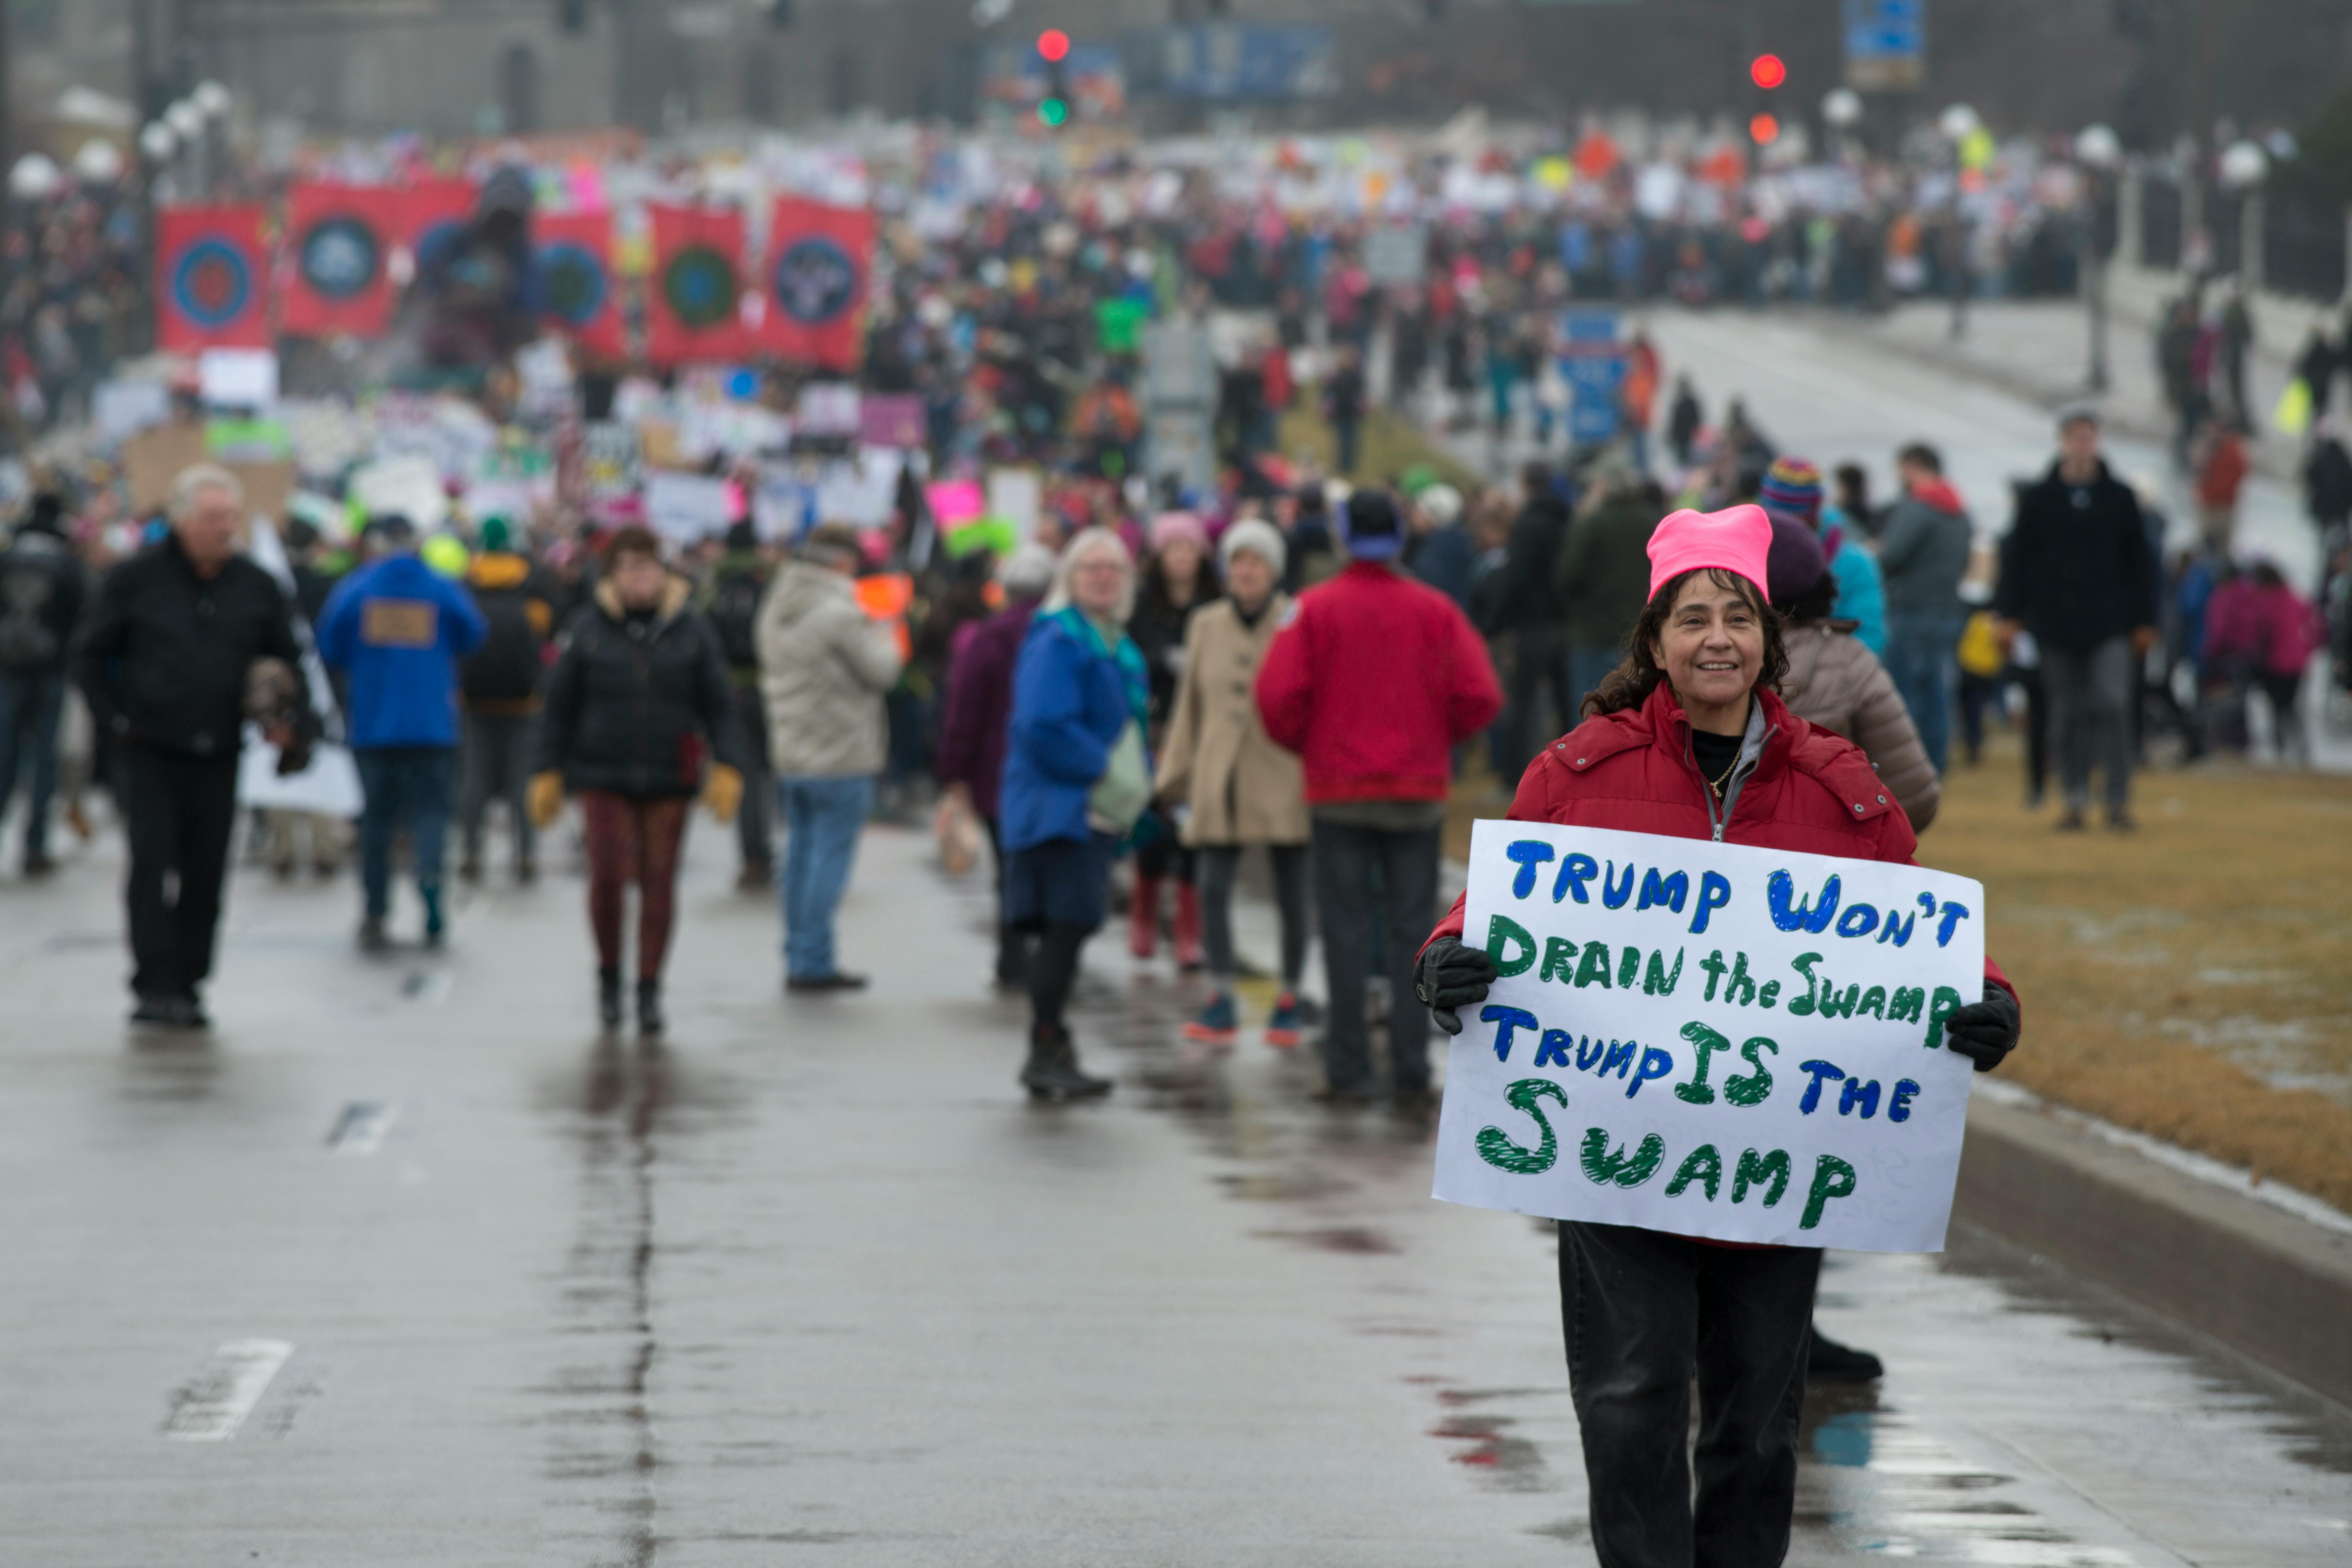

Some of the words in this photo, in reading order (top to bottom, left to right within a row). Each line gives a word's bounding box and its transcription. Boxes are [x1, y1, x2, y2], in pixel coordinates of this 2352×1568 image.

[1506, 840, 1731, 934] TRUMP
[1767, 868, 1970, 948] WON'T
[1485, 914, 1684, 996] DRAIN
[1699, 949, 1780, 1009] the
[1787, 951, 1962, 1049] SWAMP
[1479, 1004, 1674, 1099] TRUMP
[1674, 1020, 1779, 1108] IS
[1798, 1059, 1921, 1123] THE
[1475, 1078, 1856, 1230] SWAMP
